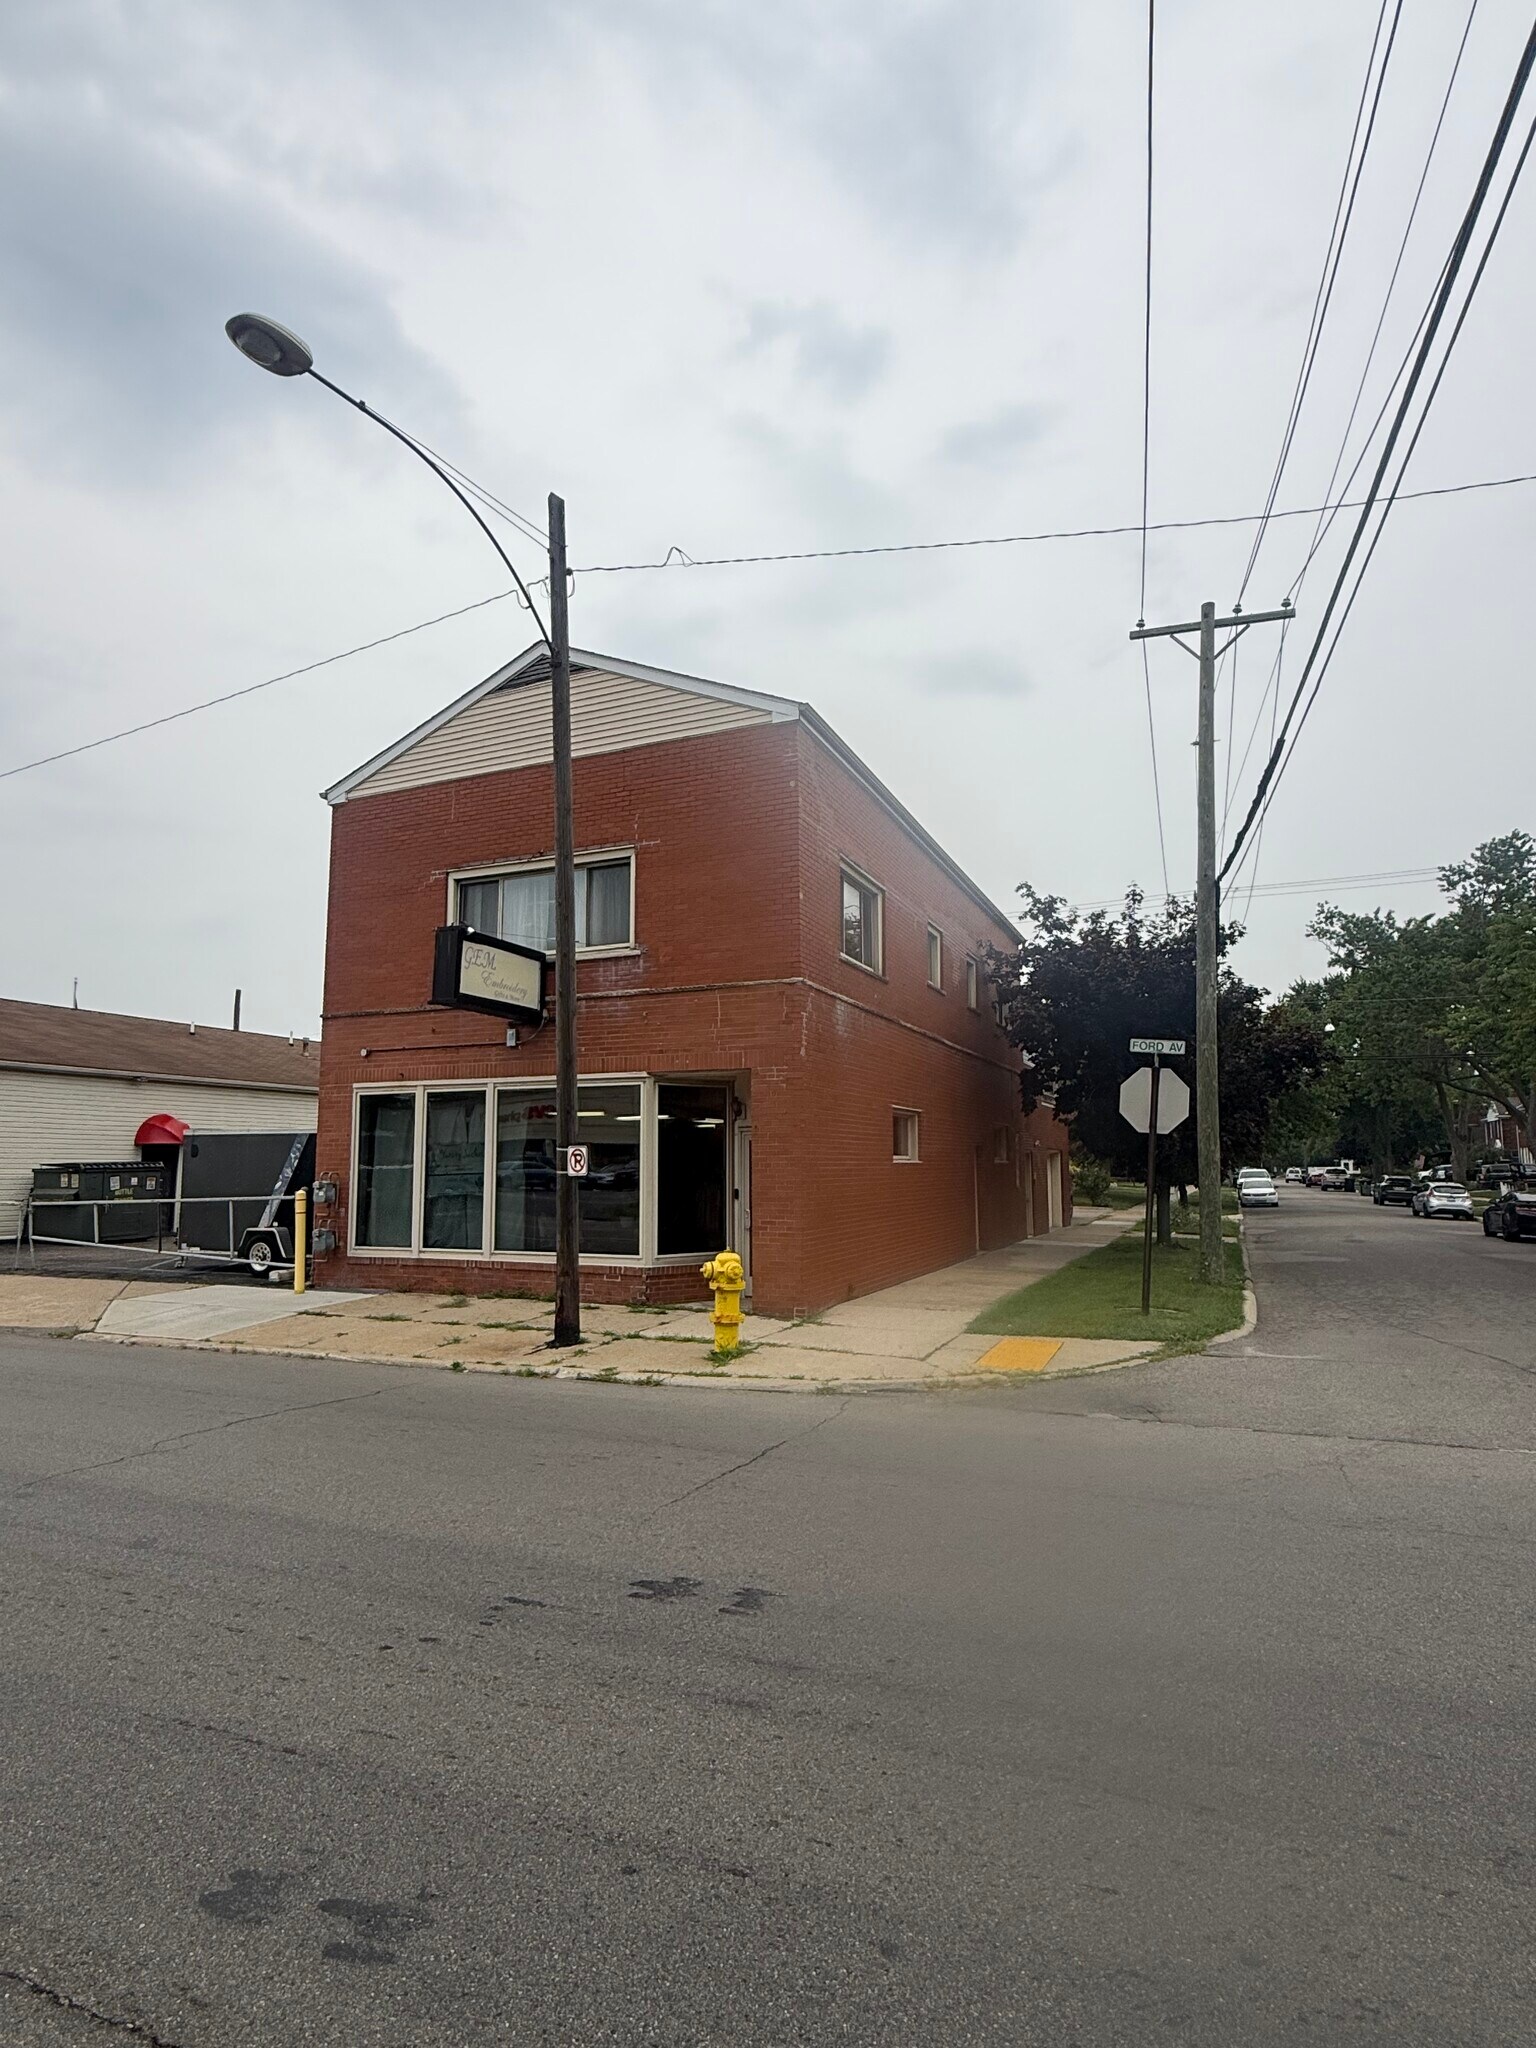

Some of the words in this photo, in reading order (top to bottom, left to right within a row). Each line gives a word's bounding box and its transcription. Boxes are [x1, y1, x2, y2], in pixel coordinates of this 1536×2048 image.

[481, 970, 528, 998] Embroidery
[1132, 1040, 1164, 1052] FORD
[1169, 1042, 1184, 1052] AV
